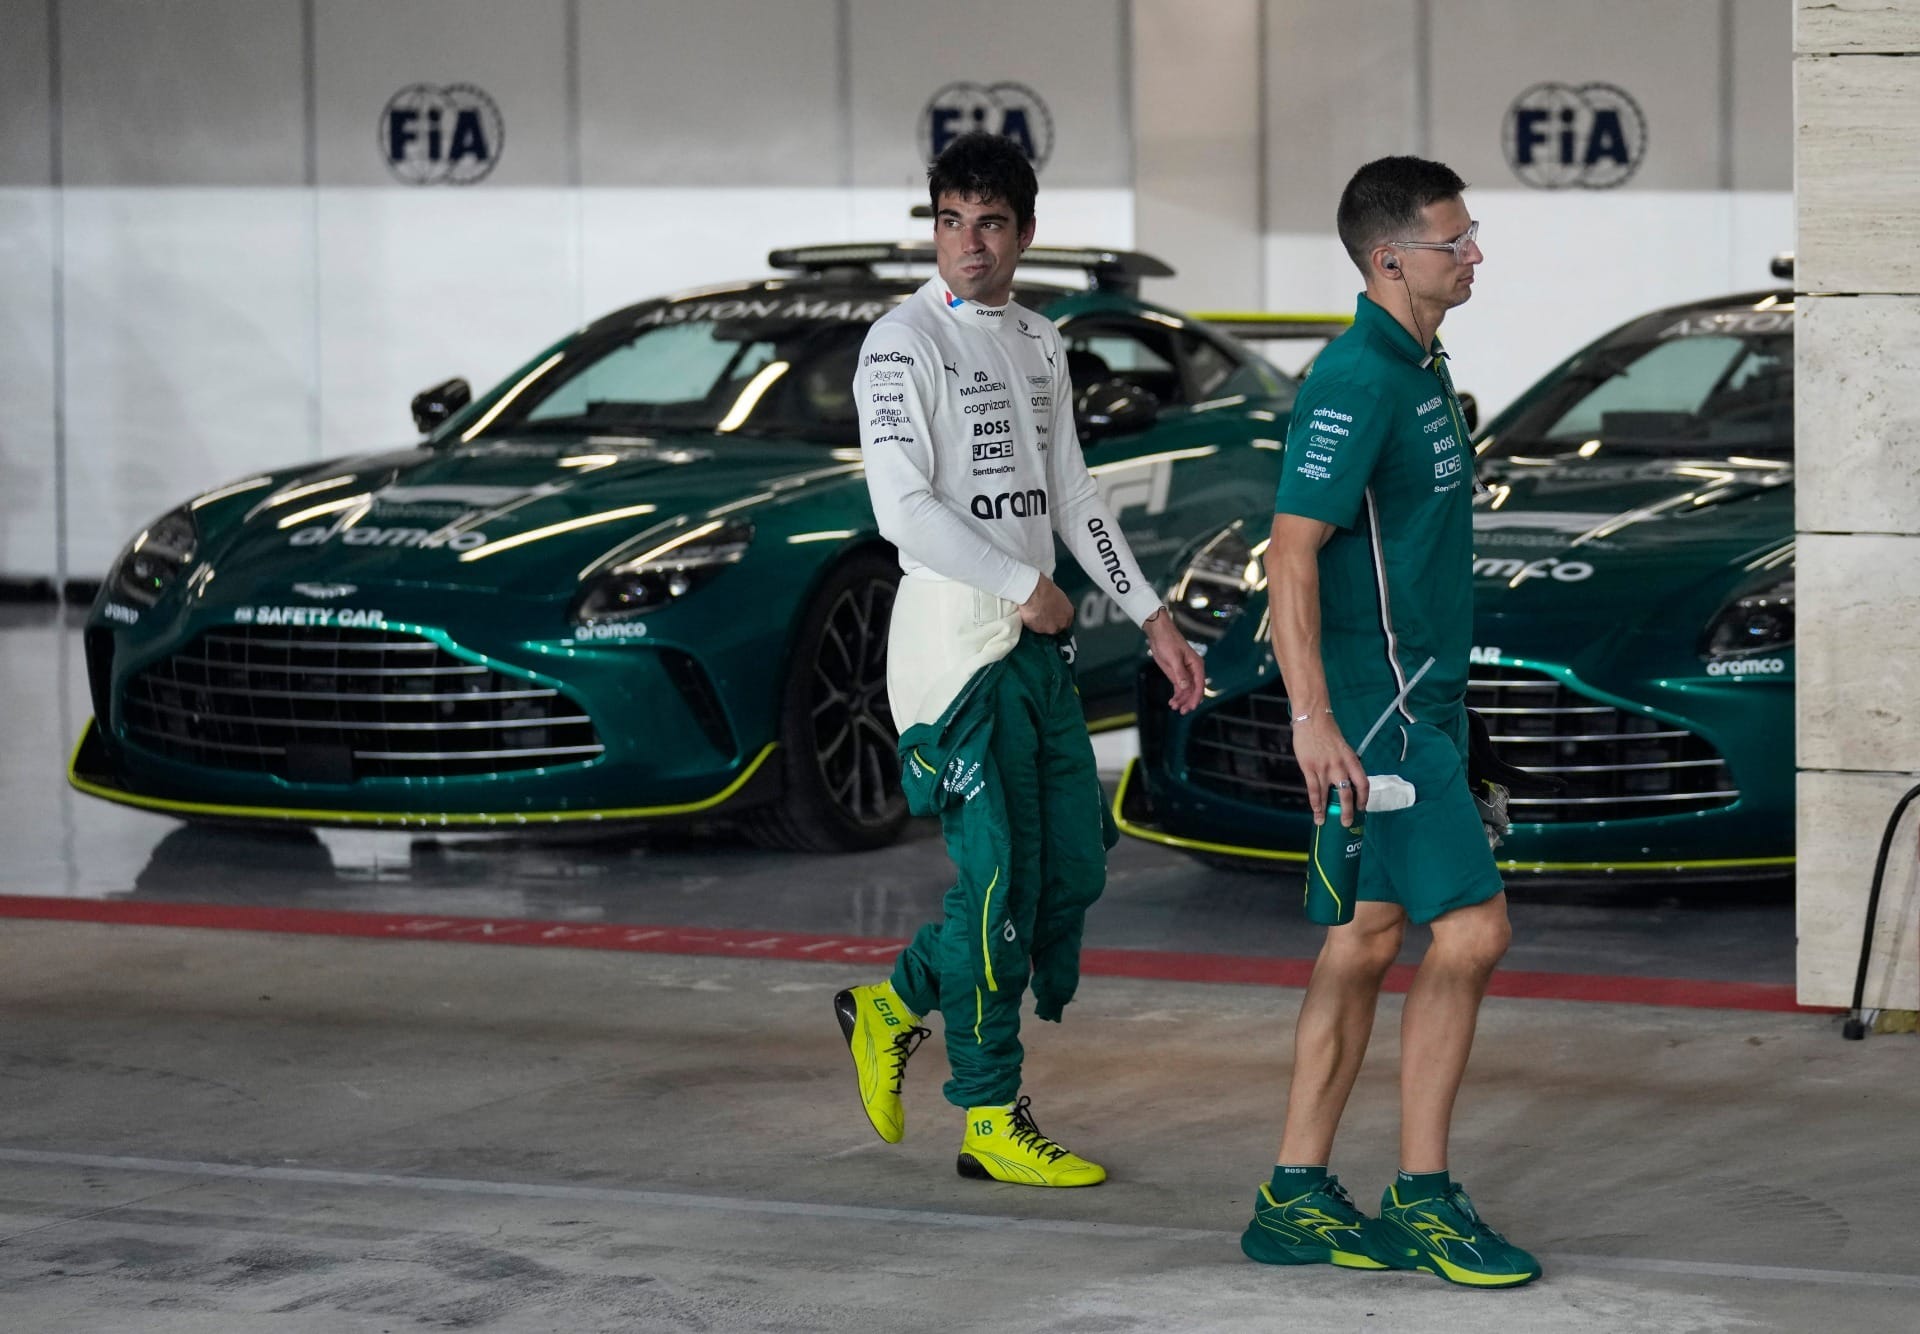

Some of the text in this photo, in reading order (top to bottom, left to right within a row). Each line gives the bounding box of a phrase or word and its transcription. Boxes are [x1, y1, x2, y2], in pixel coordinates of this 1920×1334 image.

[781, 299, 892, 322] MAR
[870, 351, 914, 367] NexGen
[959, 381, 1006, 397] MAADEN
[876, 408, 902, 417] GIRARD
[964, 398, 1011, 415] cognizant
[1313, 407, 1353, 423] coinbase
[973, 420, 1011, 437] BOSS
[1314, 420, 1349, 437] NexGen
[873, 435, 915, 445] ATLAS AIR
[1433, 434, 1456, 455] BOSS
[973, 441, 1013, 461] JCB
[1435, 454, 1462, 479] JCB
[971, 488, 1047, 520] aram
[1087, 518, 1131, 595] aramco
[256, 606, 333, 627] SAFETY
[337, 609, 384, 628] CAR
[575, 621, 647, 641] aramco
[1471, 646, 1501, 664] AR
[1706, 658, 1785, 678] aramco
[972, 1119, 994, 1137] 18
